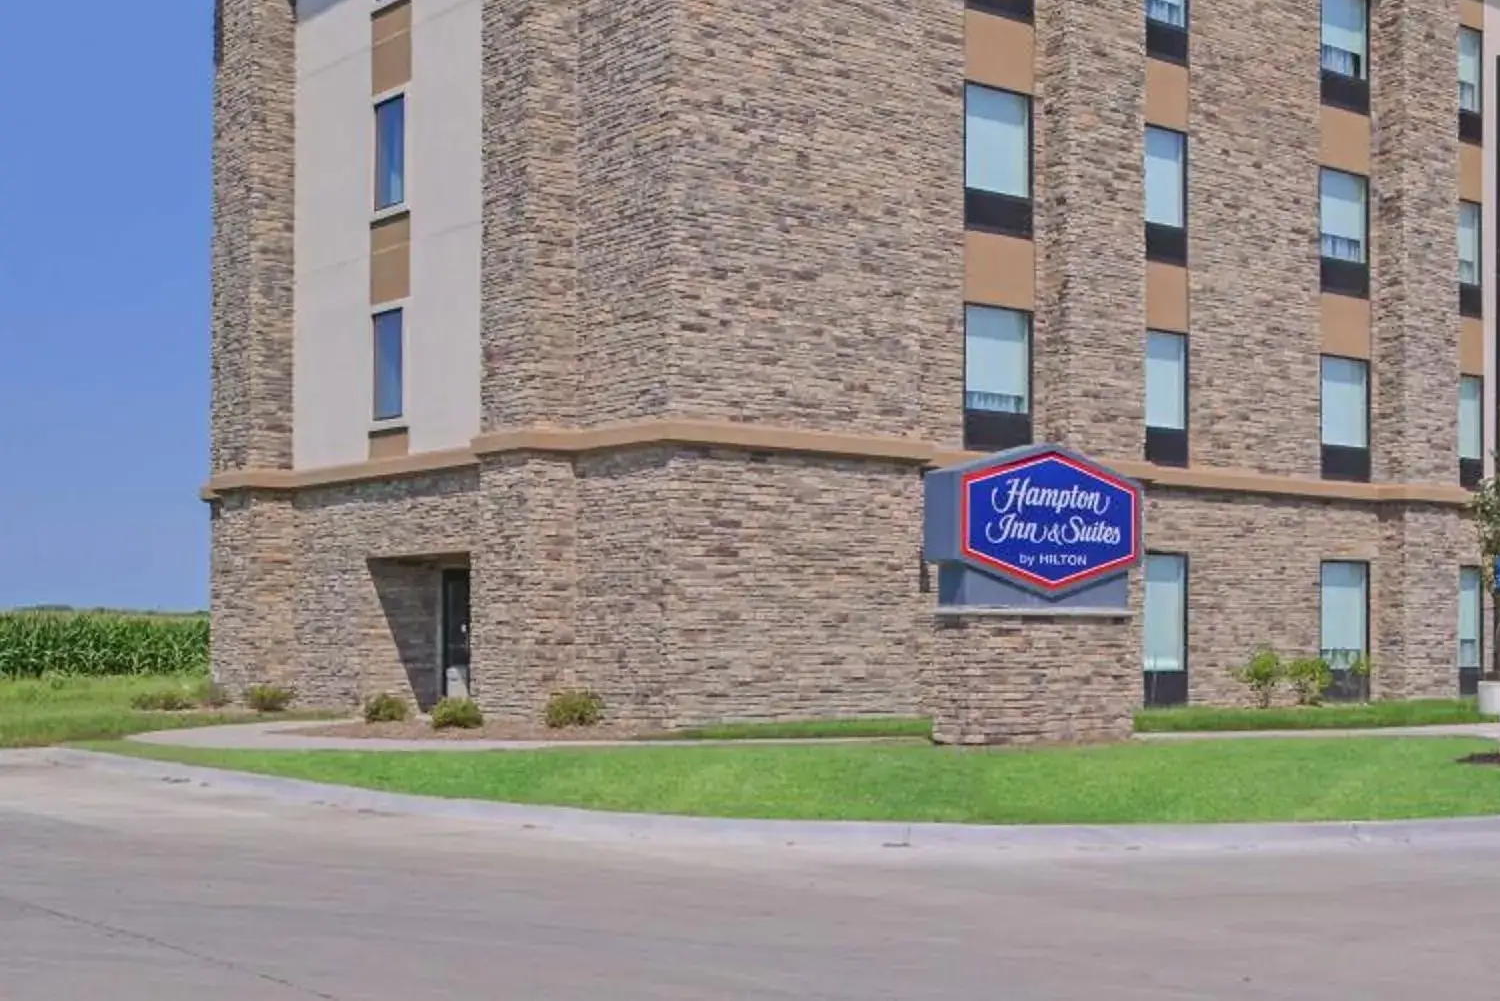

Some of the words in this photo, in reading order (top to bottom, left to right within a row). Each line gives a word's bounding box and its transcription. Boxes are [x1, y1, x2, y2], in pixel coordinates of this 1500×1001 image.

[991, 477, 1110, 515] Hampton
[985, 514, 1049, 544] Inn
[1049, 523, 1064, 546] &
[1061, 517, 1121, 545] Suites
[1019, 554, 1035, 567] by
[1039, 555, 1087, 566] HILTON
